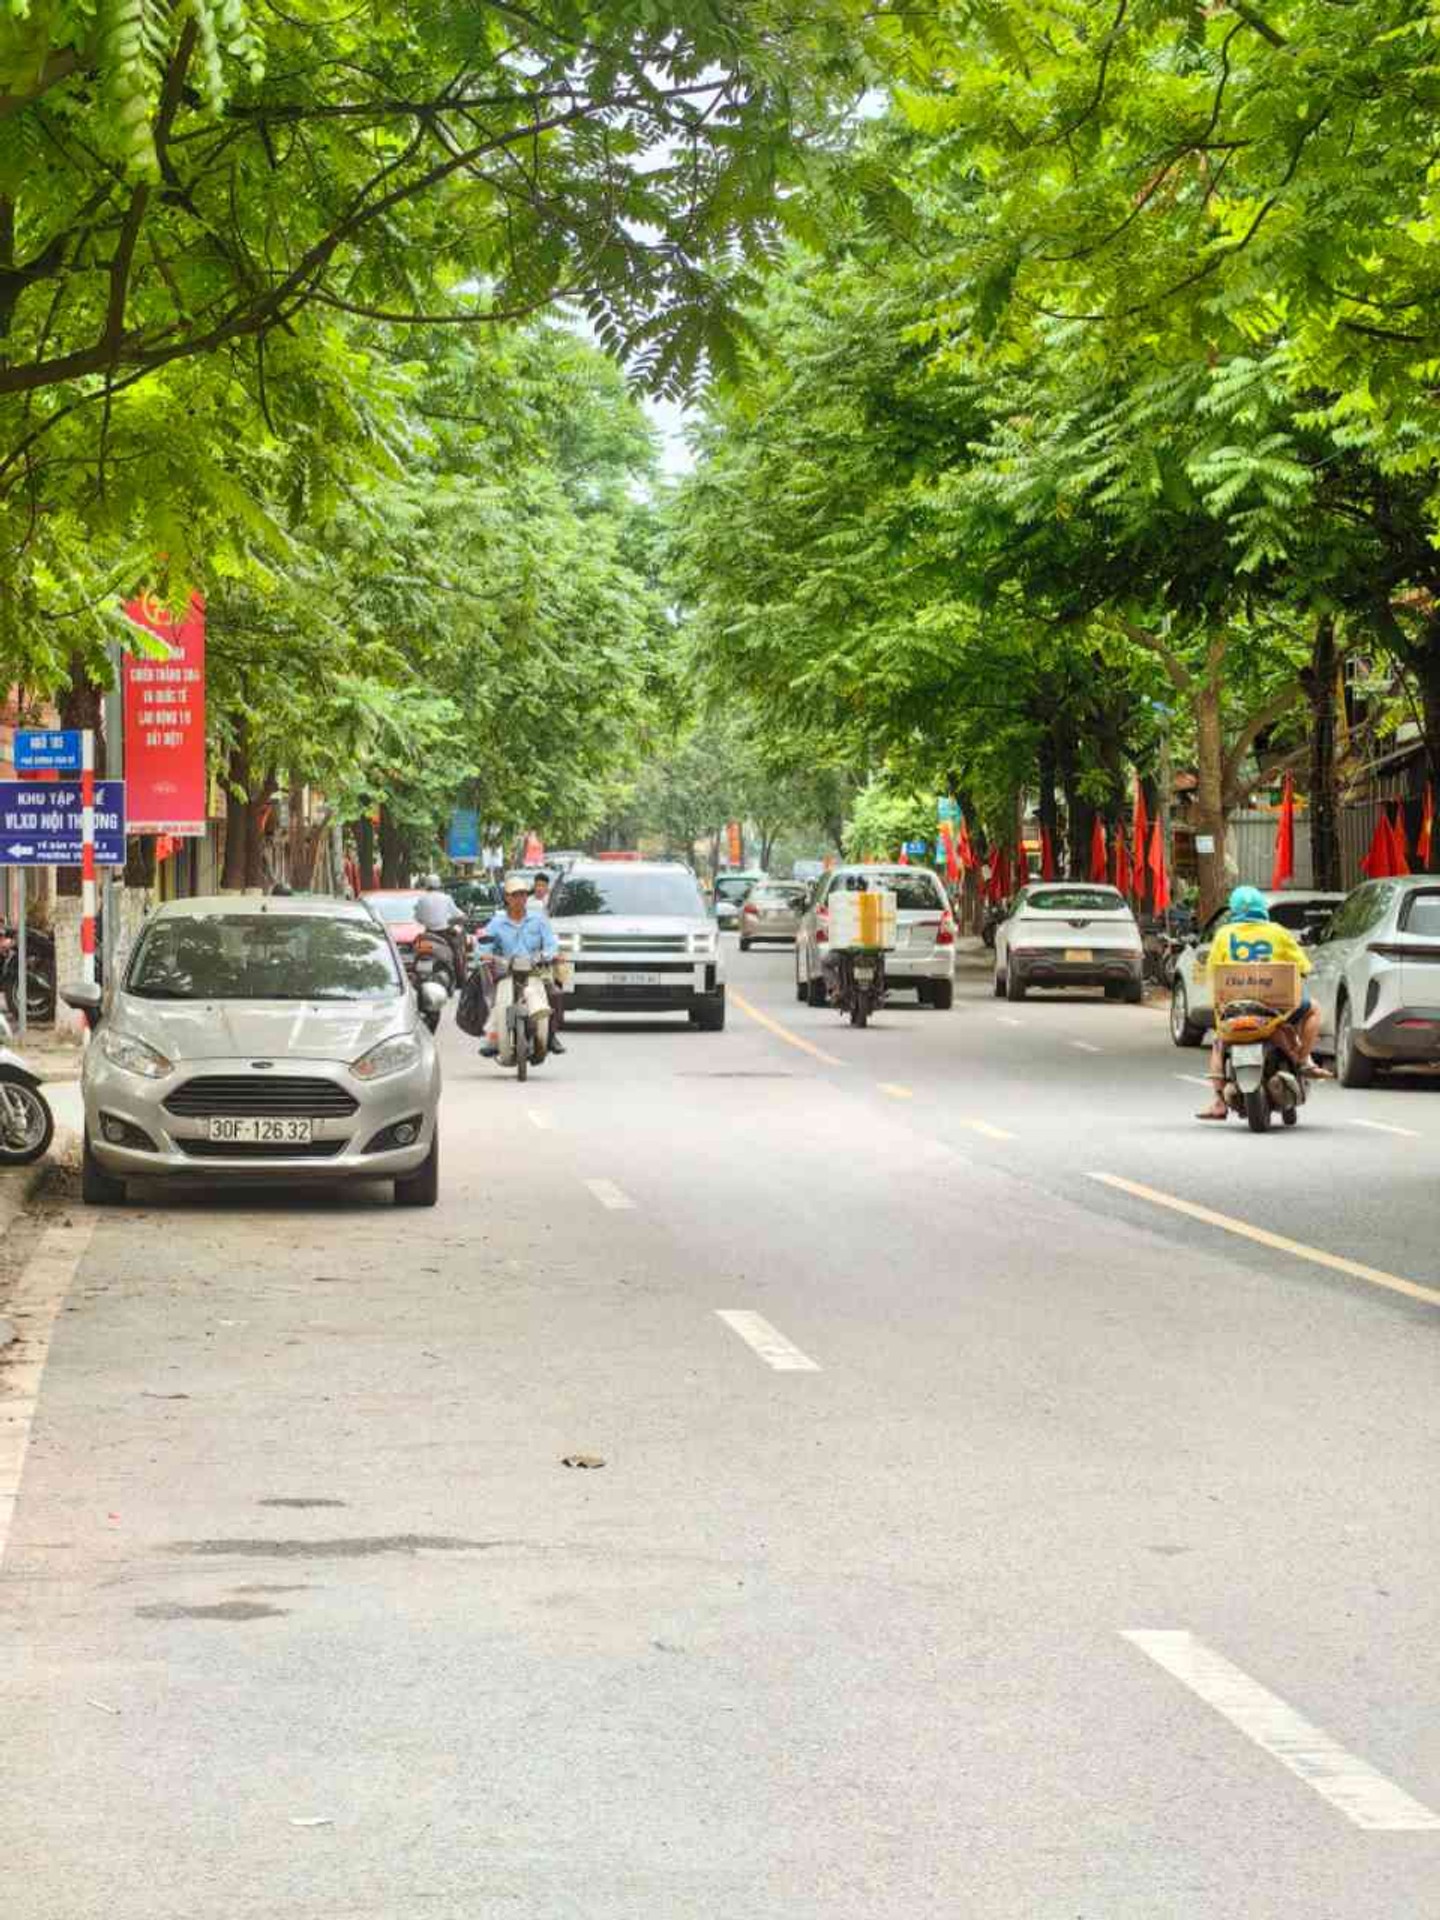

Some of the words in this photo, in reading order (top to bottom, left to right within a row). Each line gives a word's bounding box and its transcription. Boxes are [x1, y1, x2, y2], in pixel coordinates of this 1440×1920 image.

[18, 792, 46, 805] KHU
[49, 789, 75, 808] TẬP
[41, 810, 63, 834] NỘI
[68, 813, 118, 830] THNG
[1230, 933, 1273, 962] be
